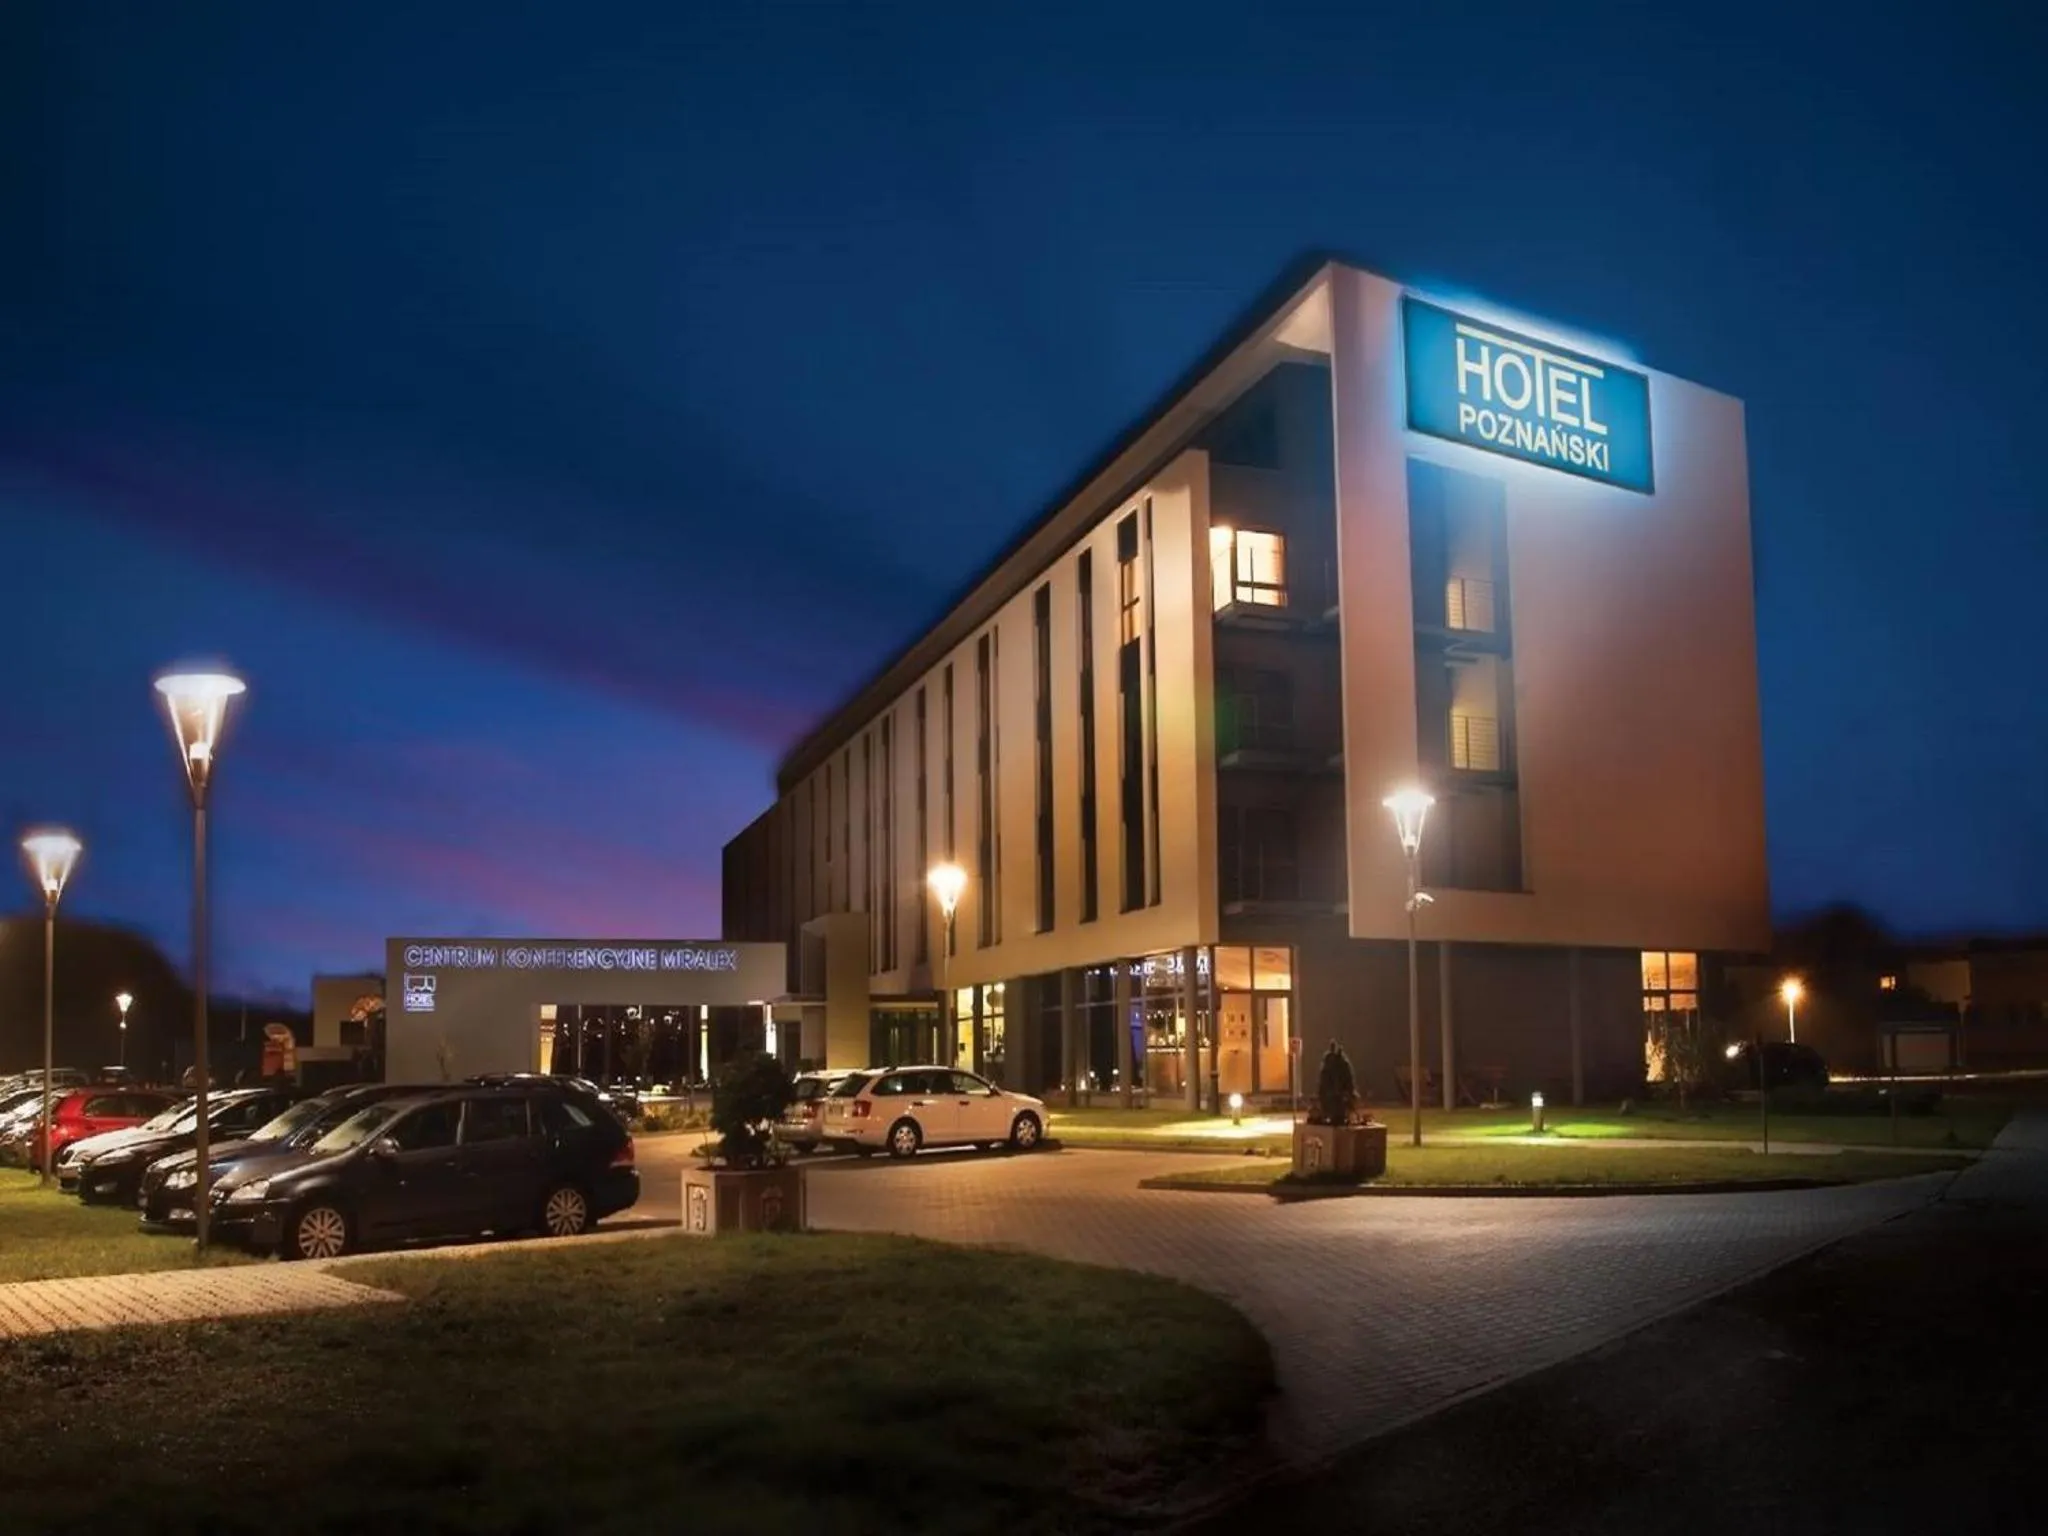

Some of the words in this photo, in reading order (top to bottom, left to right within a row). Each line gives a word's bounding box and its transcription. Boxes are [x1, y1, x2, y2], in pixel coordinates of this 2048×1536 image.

[1456, 323, 1607, 435] HOTEL
[1459, 403, 1609, 471] POZNAŃSKI
[405, 945, 497, 968] CENTRUM
